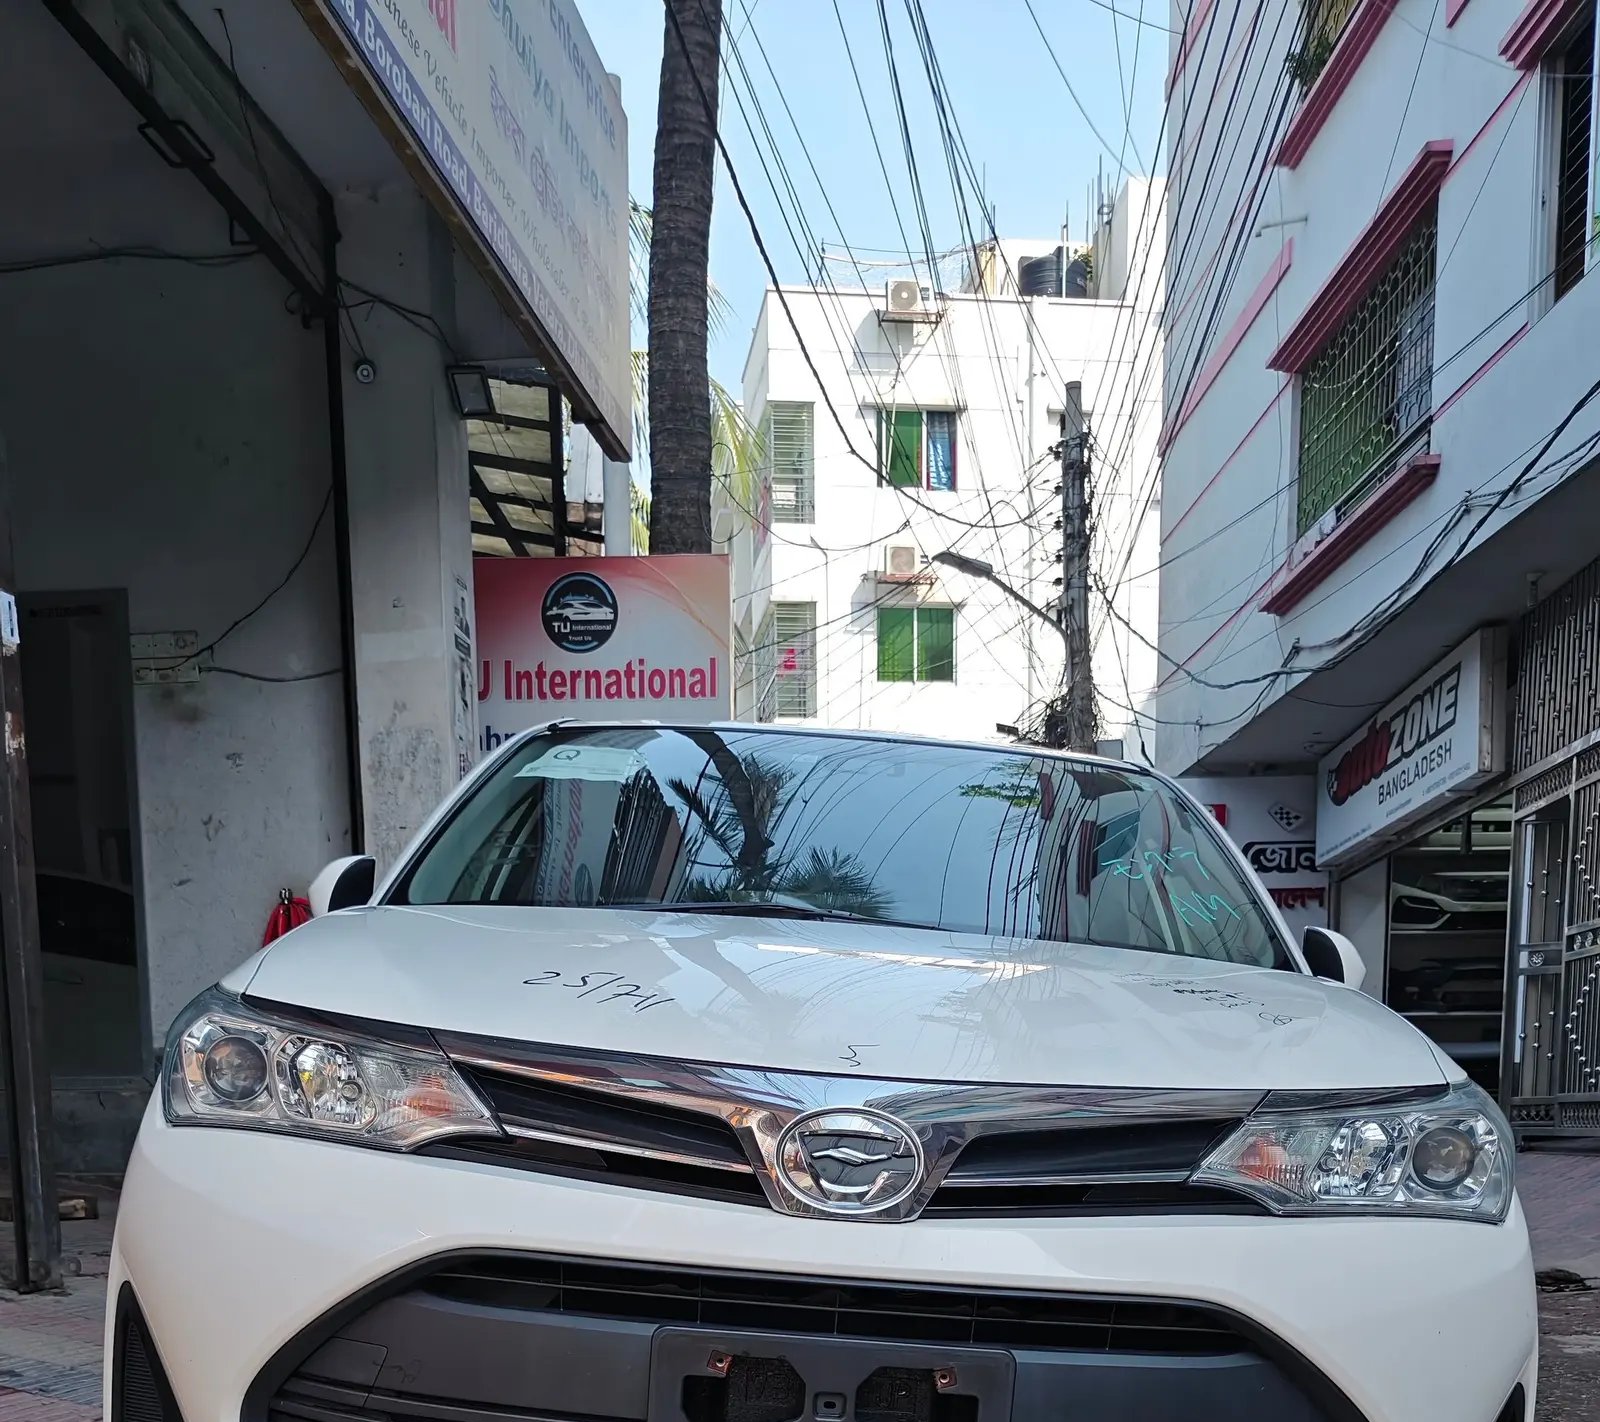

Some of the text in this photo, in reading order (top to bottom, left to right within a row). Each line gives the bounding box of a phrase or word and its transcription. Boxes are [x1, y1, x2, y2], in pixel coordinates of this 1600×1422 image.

[424, 50, 468, 135] Vehicle
[364, 9, 430, 140] Borobari
[434, 119, 470, 202] Road,
[473, 181, 531, 296] Baridhara,
[552, 621, 612, 633] TU International
[504, 657, 717, 701] International
[1378, 738, 1452, 805] BANGLADESH
